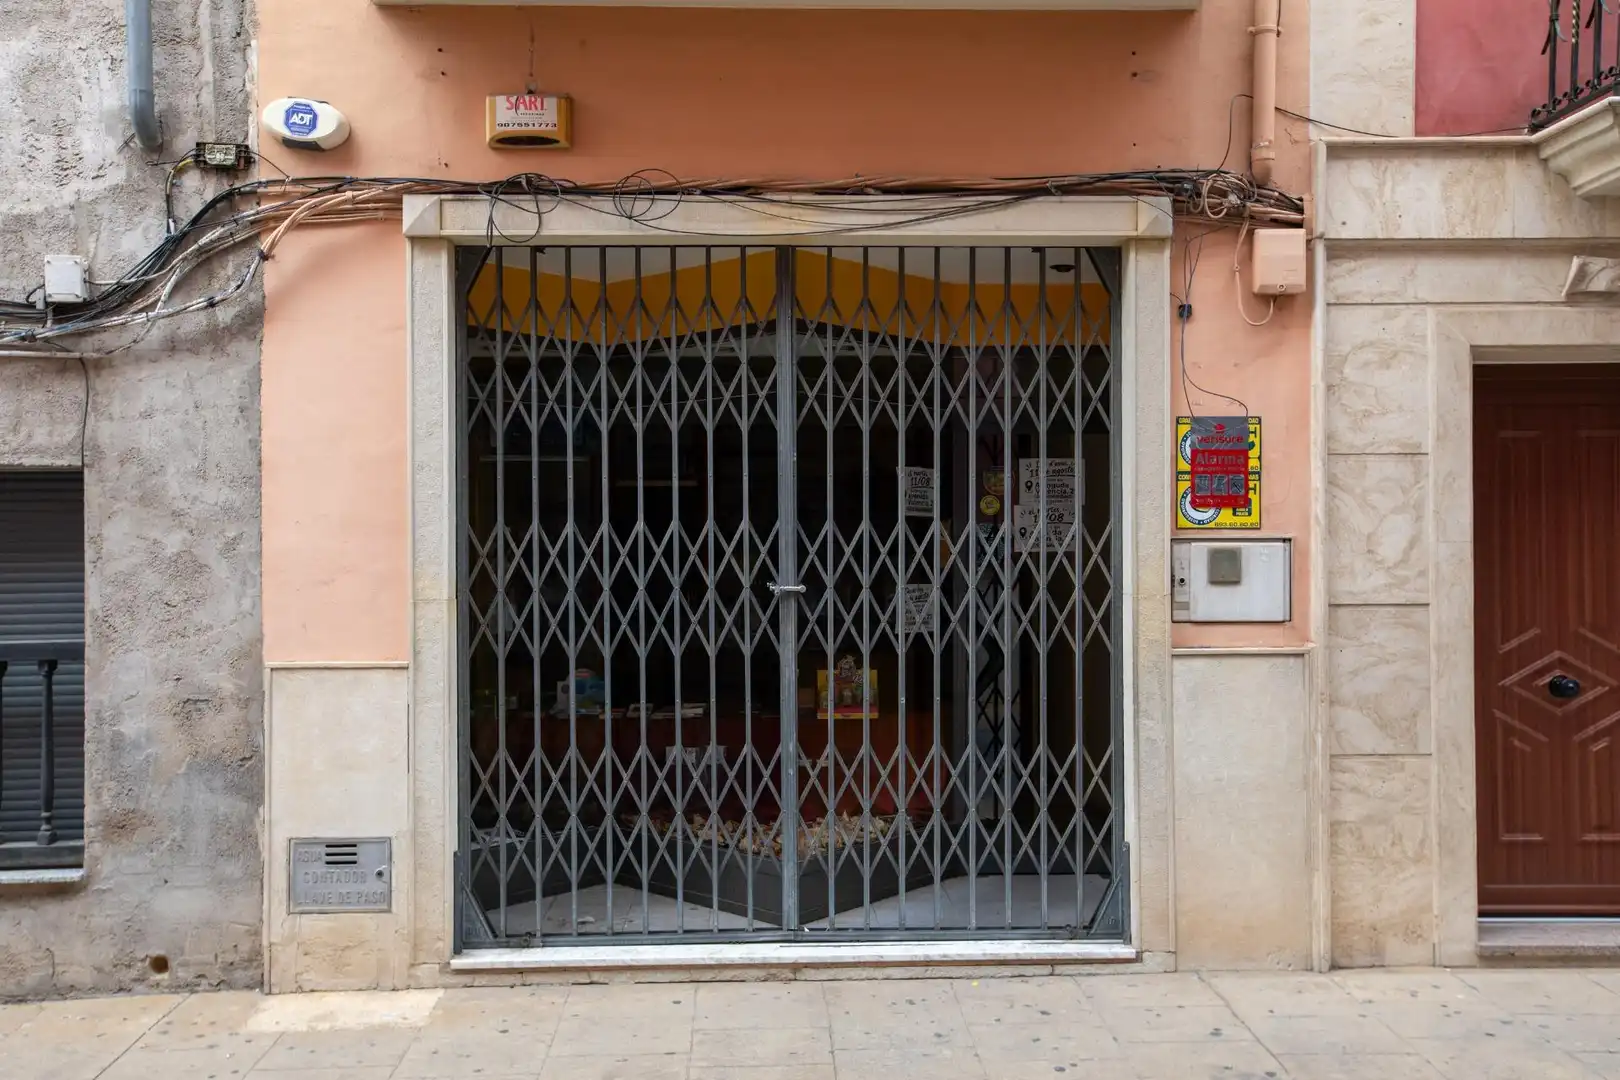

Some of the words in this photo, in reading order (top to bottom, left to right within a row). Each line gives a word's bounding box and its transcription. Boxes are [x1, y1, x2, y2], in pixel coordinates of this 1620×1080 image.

[290, 113, 313, 126] ADT
[1196, 452, 1245, 465] Alarma
[911, 477, 931, 486] 11/08
[303, 870, 367, 884] CONTADOR
[297, 891, 333, 905] LLAVE
[338, 891, 352, 904] DE
[357, 891, 386, 904] PASO
